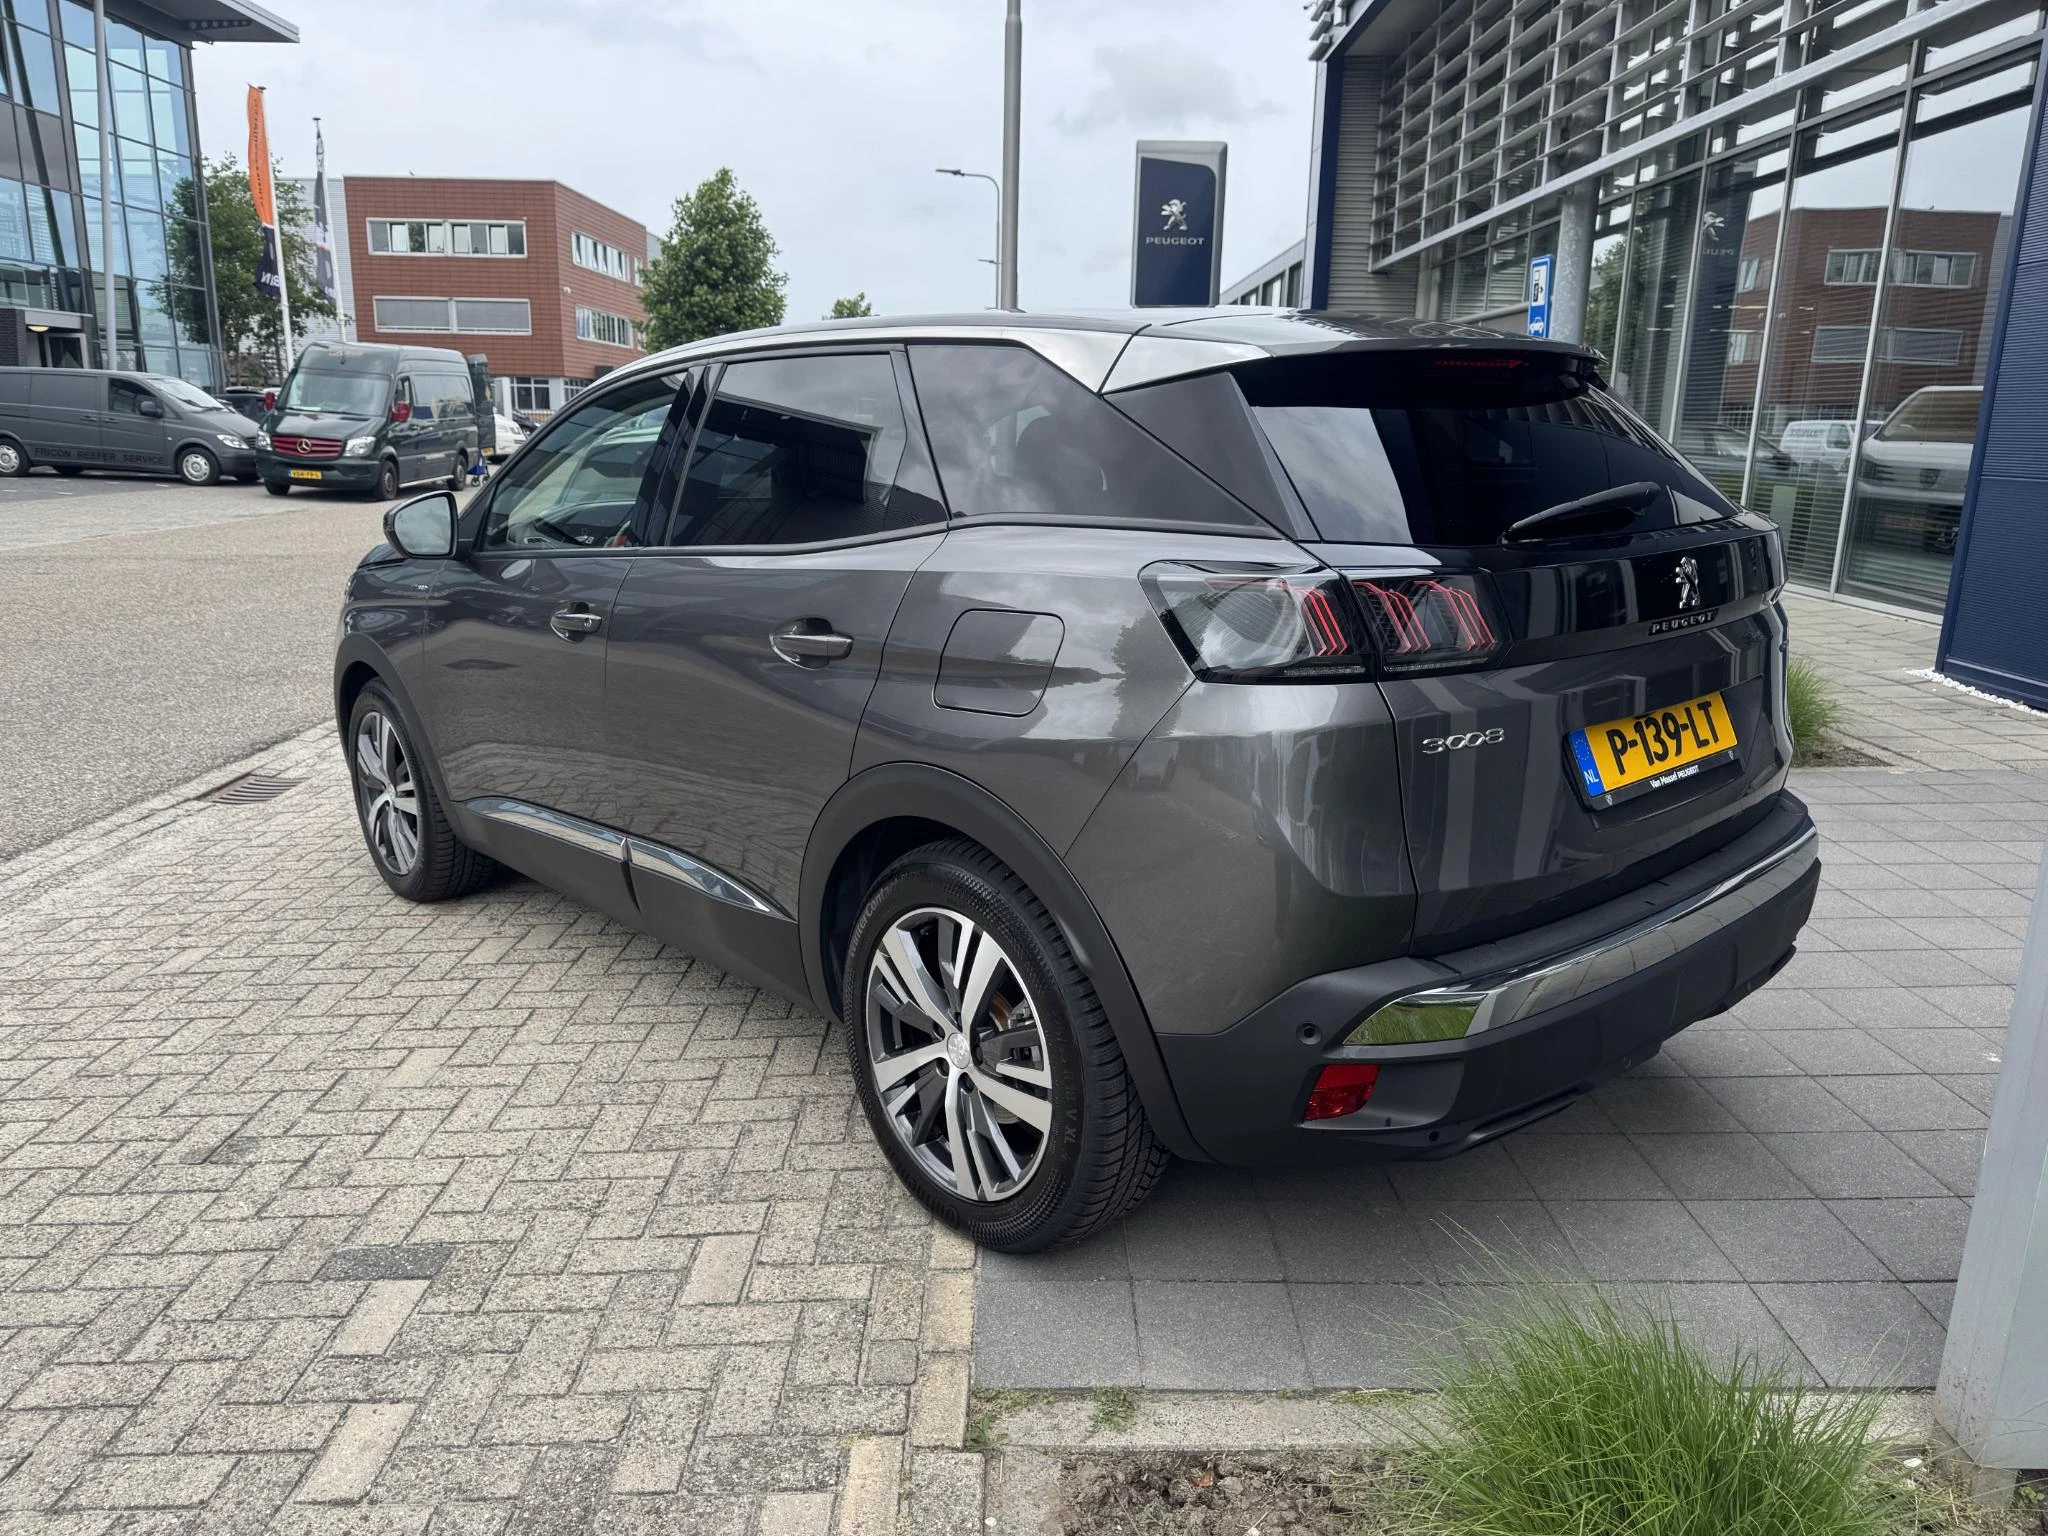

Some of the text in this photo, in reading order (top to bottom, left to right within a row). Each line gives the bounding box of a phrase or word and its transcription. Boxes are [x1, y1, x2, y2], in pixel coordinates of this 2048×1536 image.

[1145, 236, 1205, 246] PEUGEOT
[34, 447, 72, 457] FRICON
[122, 454, 165, 464] SERVICE
[1651, 611, 1714, 634] PEUGEOT
[1422, 727, 1505, 754] 3008
[1605, 700, 1720, 776] P-139-LT
[1583, 769, 1600, 785] NL
[1650, 779, 1662, 789] Van
[1677, 764, 1699, 778] PEUGEOT
